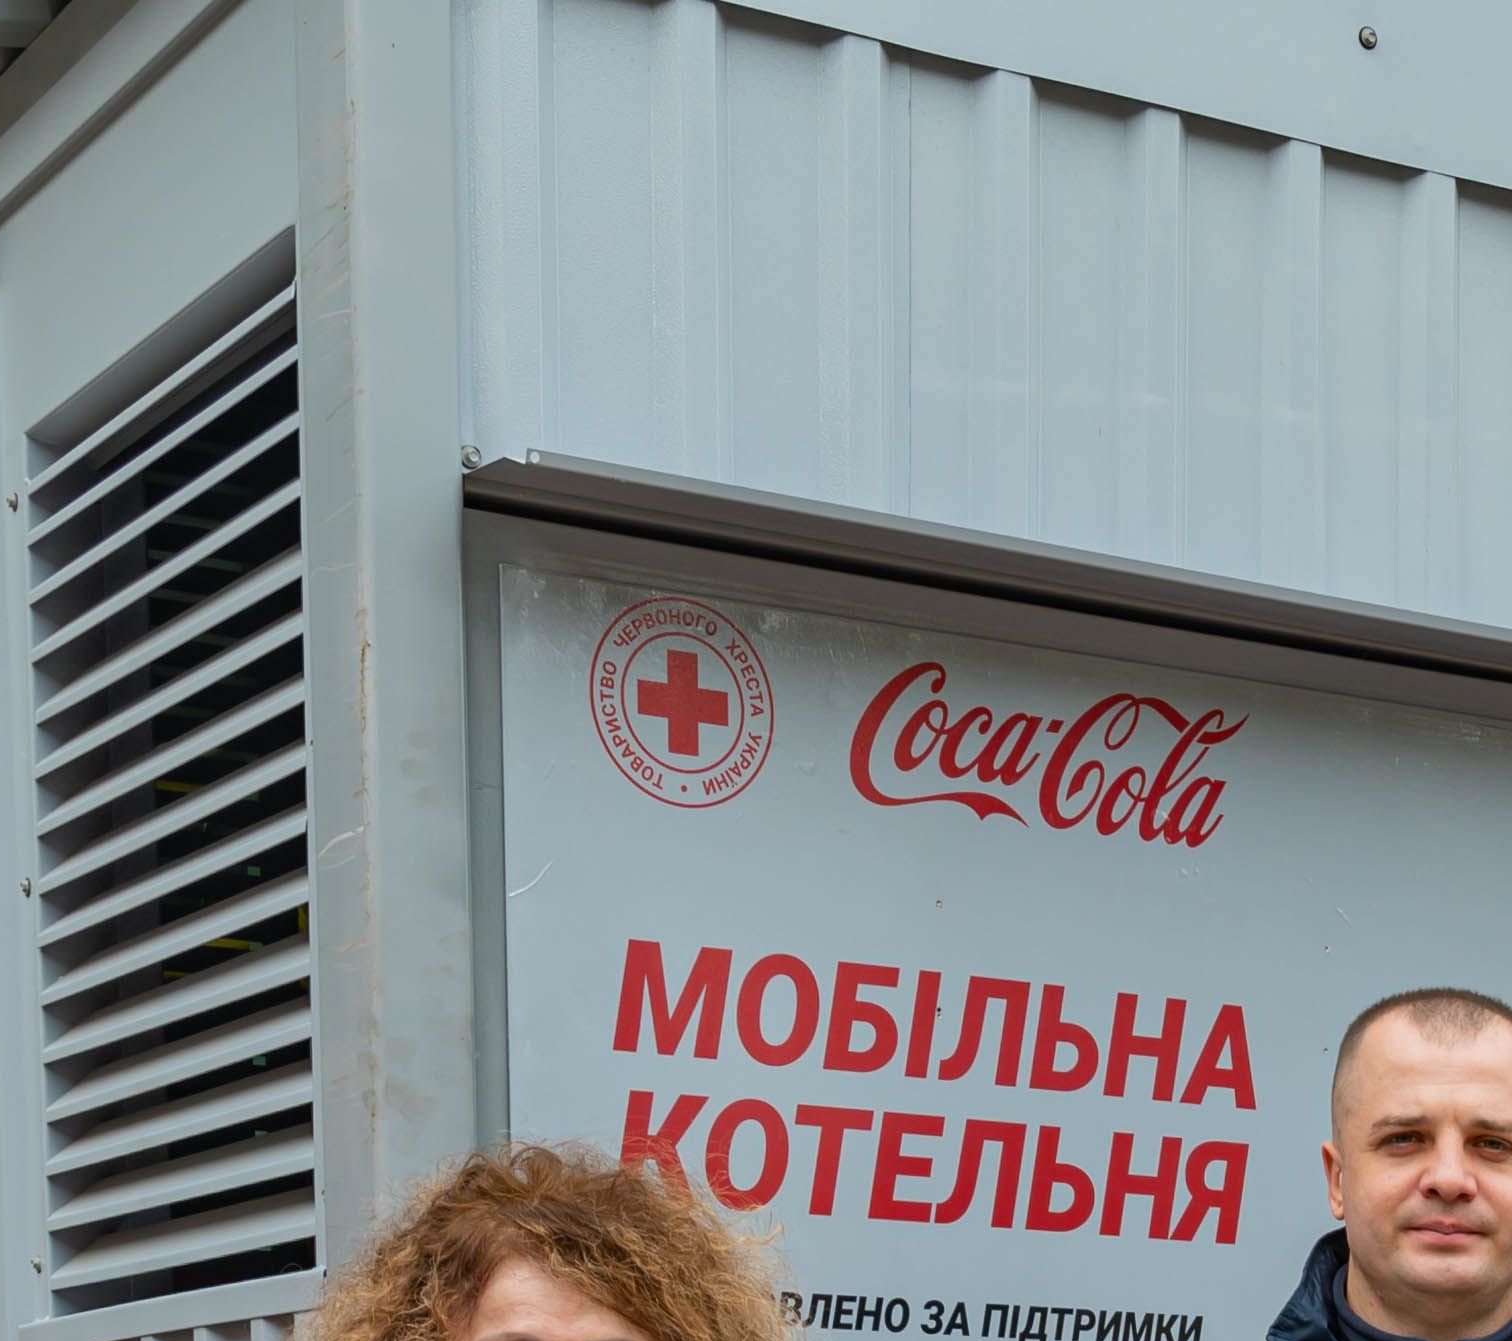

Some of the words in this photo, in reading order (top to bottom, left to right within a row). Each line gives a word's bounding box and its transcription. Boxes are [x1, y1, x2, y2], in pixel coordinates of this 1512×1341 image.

[613, 609, 718, 649] ЧЕРВОНОГО
[725, 639, 764, 717] ХРЕСТА
[599, 660, 664, 791] ТОВАРИСТВО
[702, 733, 762, 796] УКРАЇНИ
[849, 660, 1250, 850] Coca-Cola
[612, 938, 1257, 1111] МОБІЛЬНА
[620, 1090, 1250, 1246] КОТЕЛЬНЯ
[920, 1300, 970, 1337] ЗА
